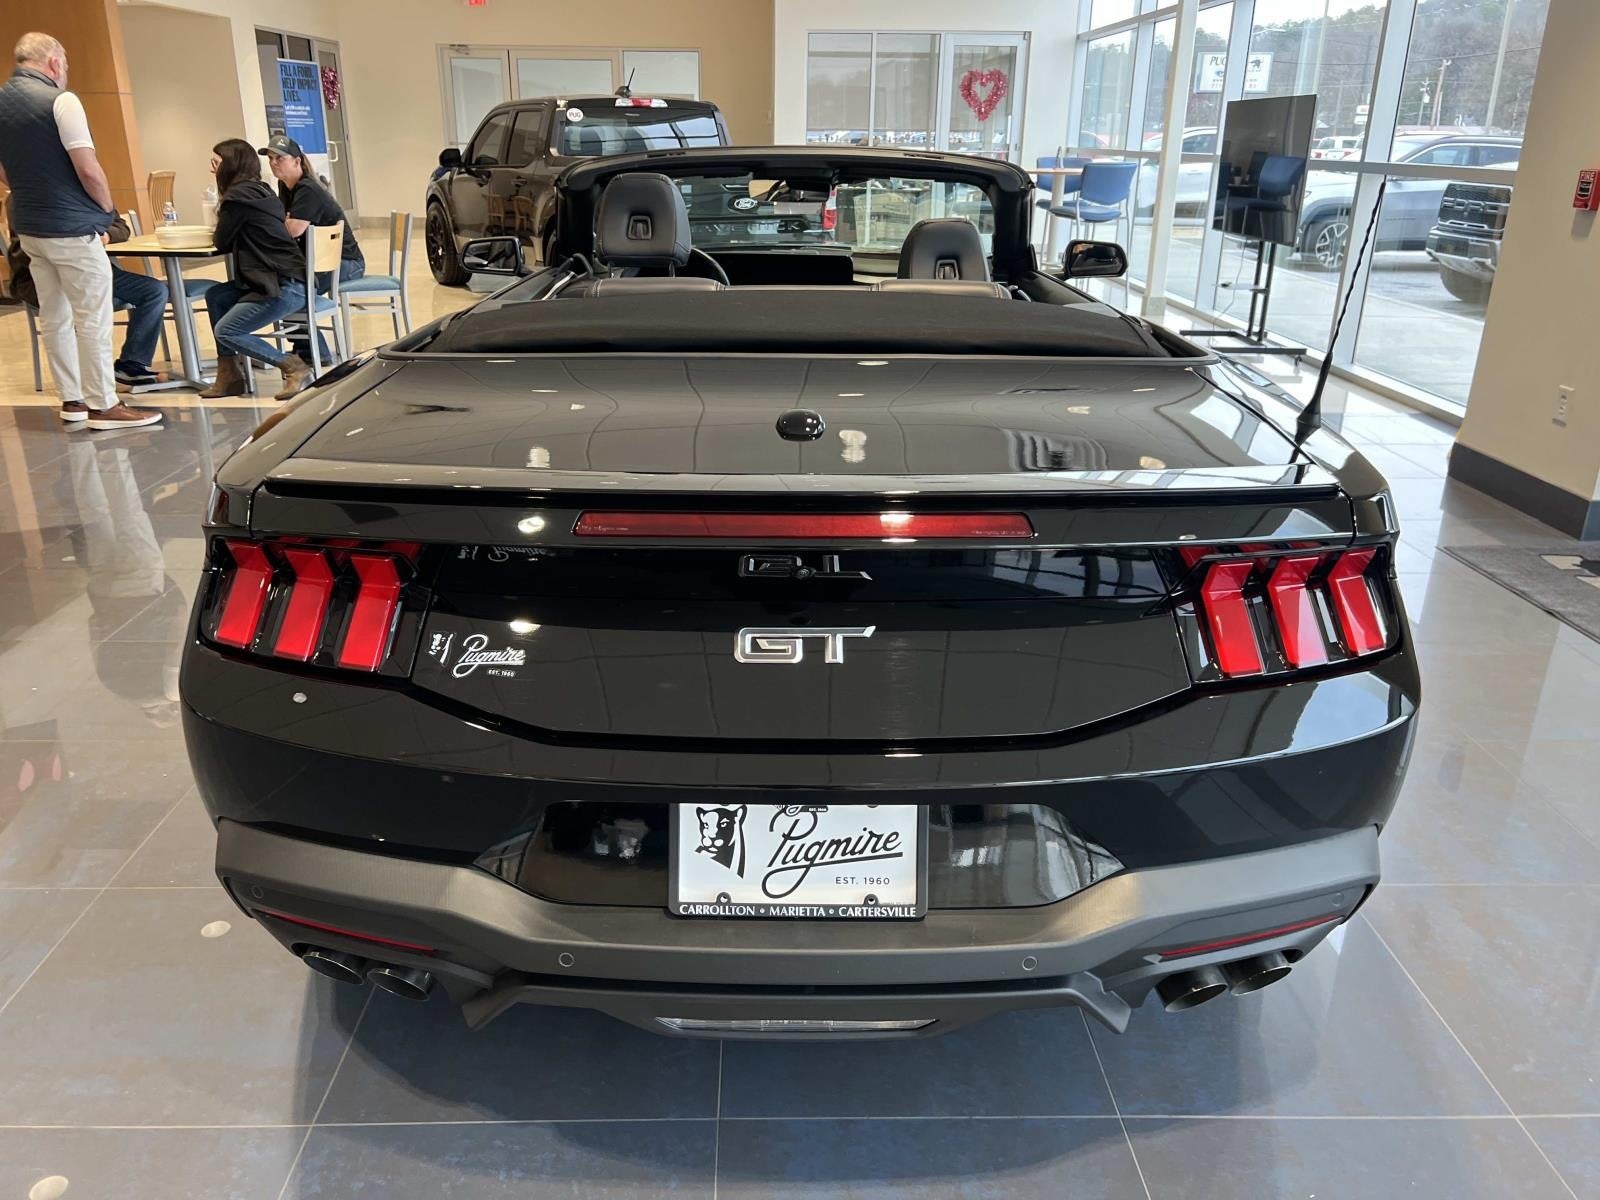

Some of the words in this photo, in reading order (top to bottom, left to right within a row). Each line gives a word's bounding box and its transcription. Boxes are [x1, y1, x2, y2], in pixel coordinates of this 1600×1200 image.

[453, 634, 526, 678] Pugmire
[734, 625, 876, 664] GT
[761, 805, 903, 898] Pugmire
[835, 876, 859, 885] EST.
[863, 876, 890, 885] 1960
[679, 904, 755, 915] CARROLLTON
[769, 905, 825, 917] MARIETTA
[838, 906, 916, 917] CARTERSVILLE
